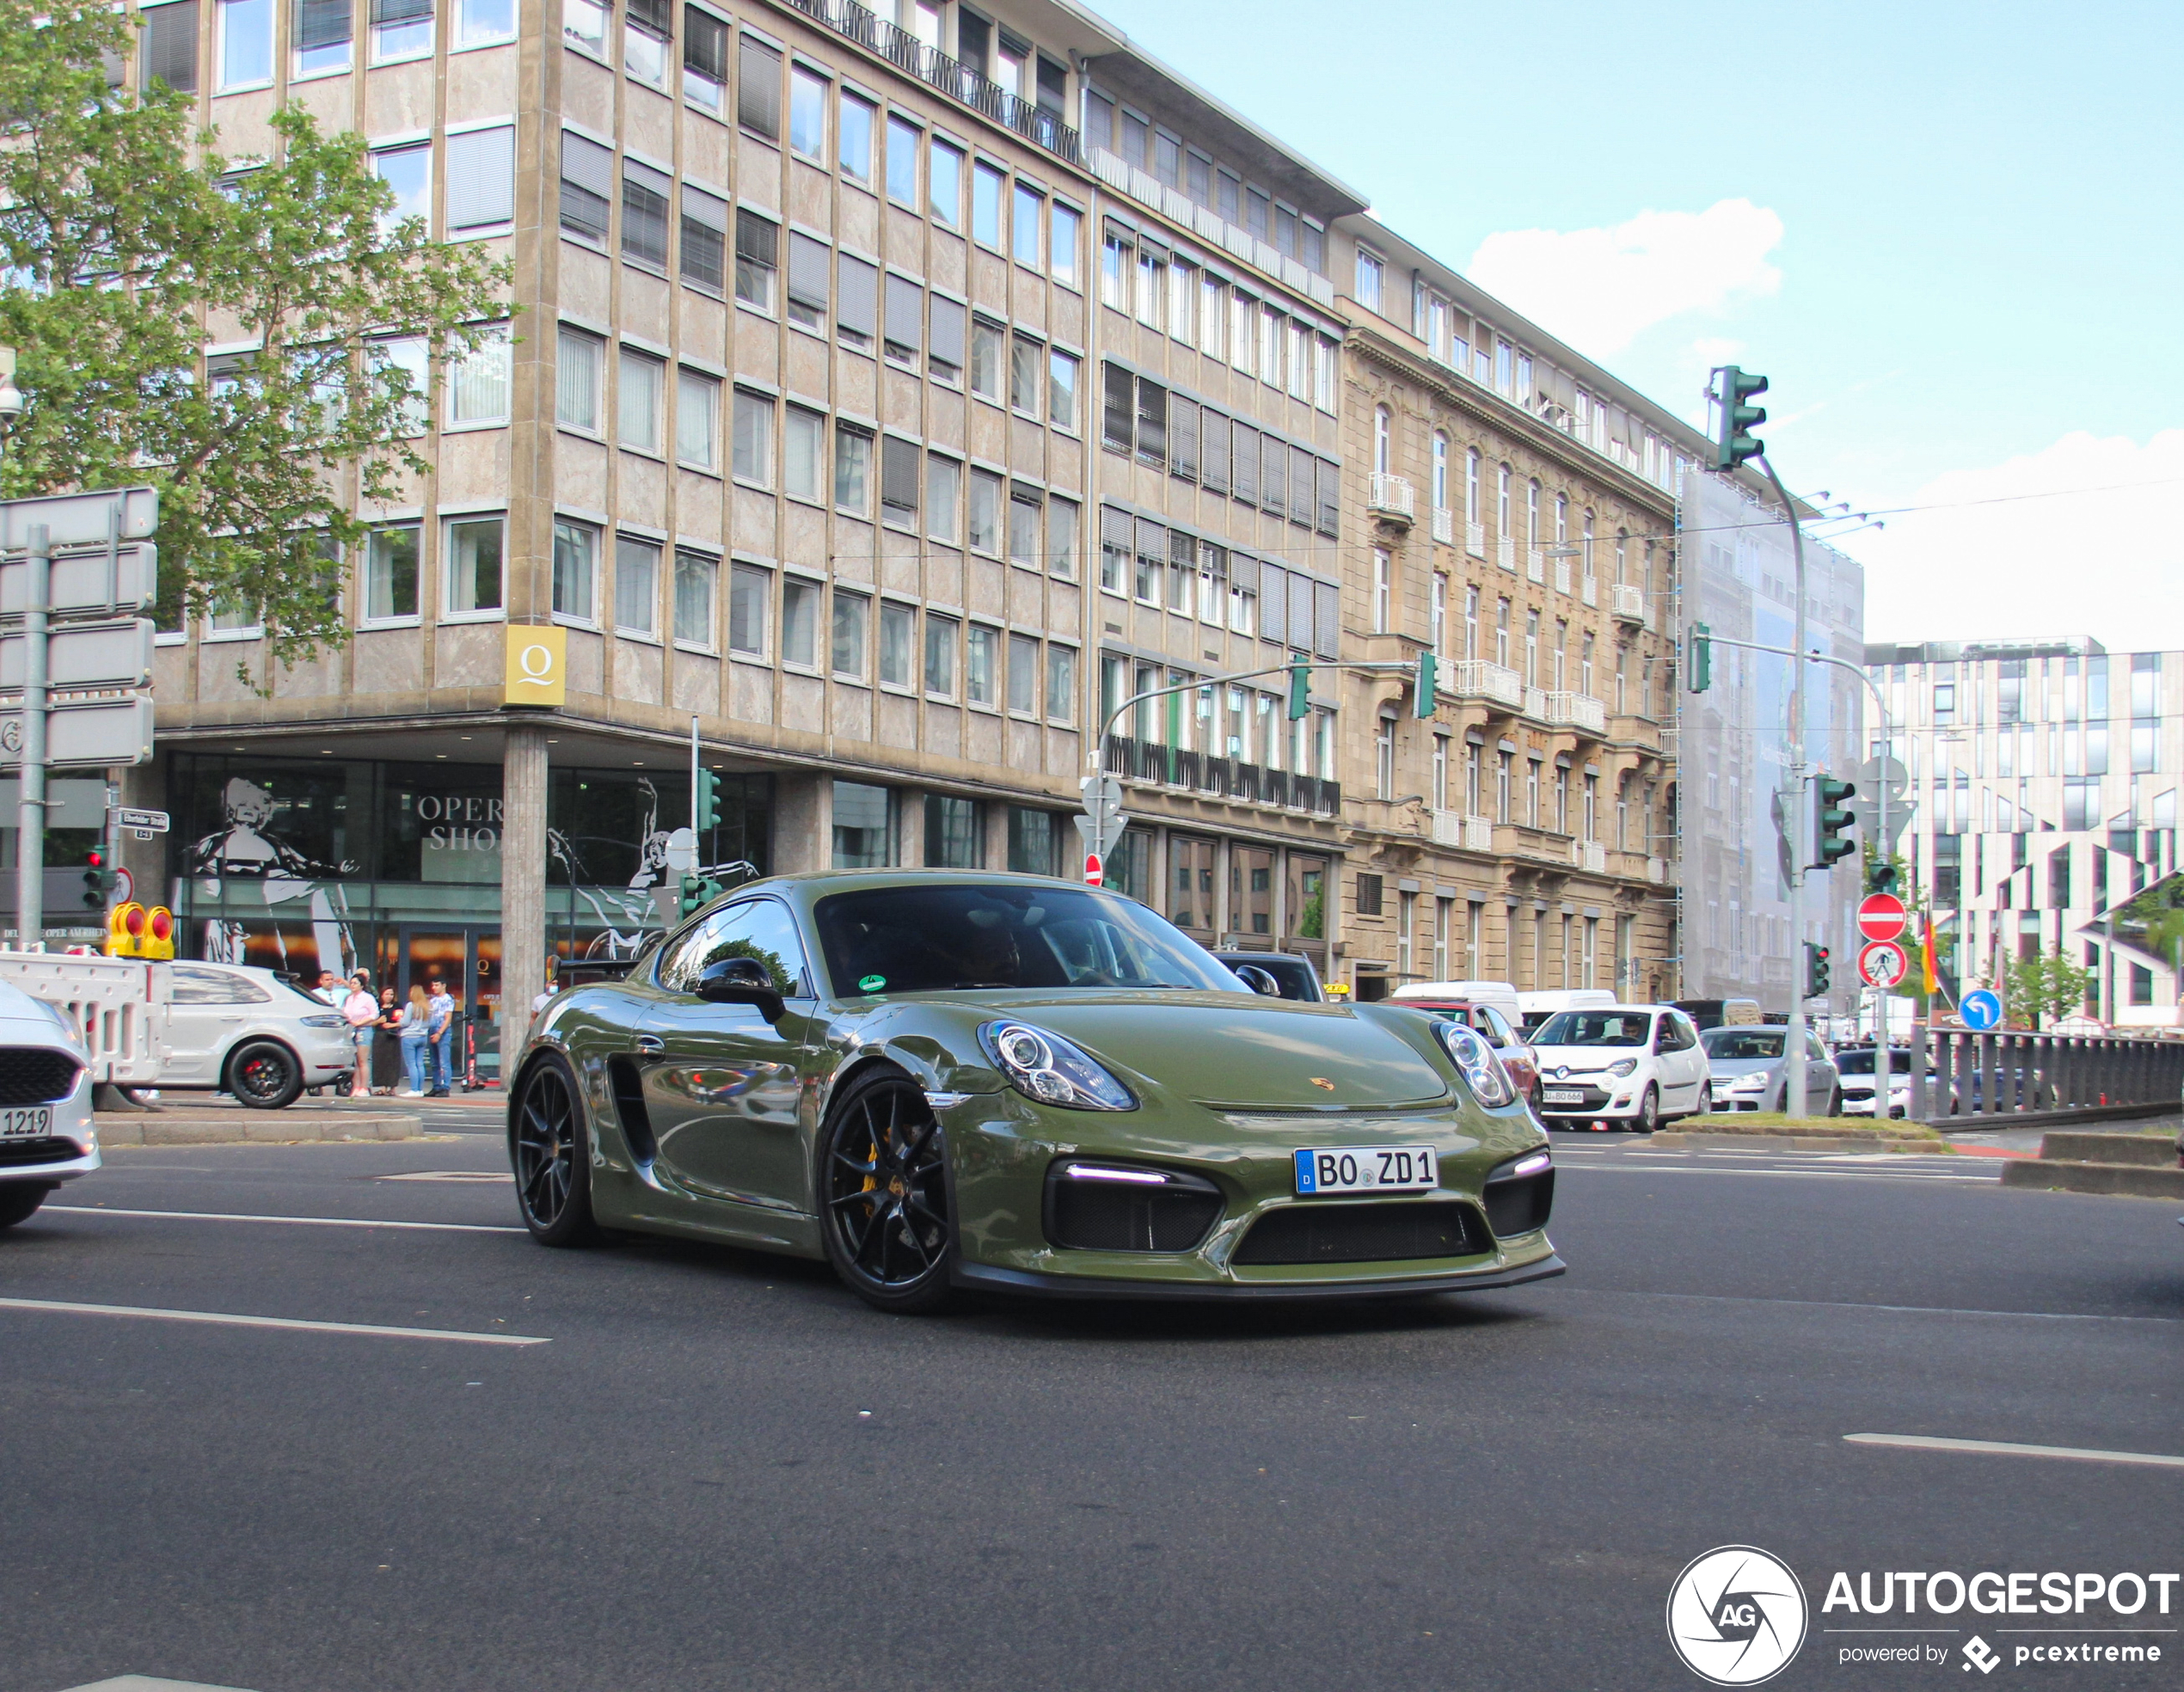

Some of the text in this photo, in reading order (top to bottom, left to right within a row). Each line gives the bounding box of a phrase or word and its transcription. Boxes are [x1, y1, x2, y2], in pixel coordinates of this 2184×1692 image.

[517, 644, 556, 686] Q
[430, 826, 504, 852] SHO
[46, 929, 67, 938] OPER
[3, 1109, 49, 1135] 1219
[1303, 1174, 1311, 1185] D
[1317, 1154, 1358, 1186] BO
